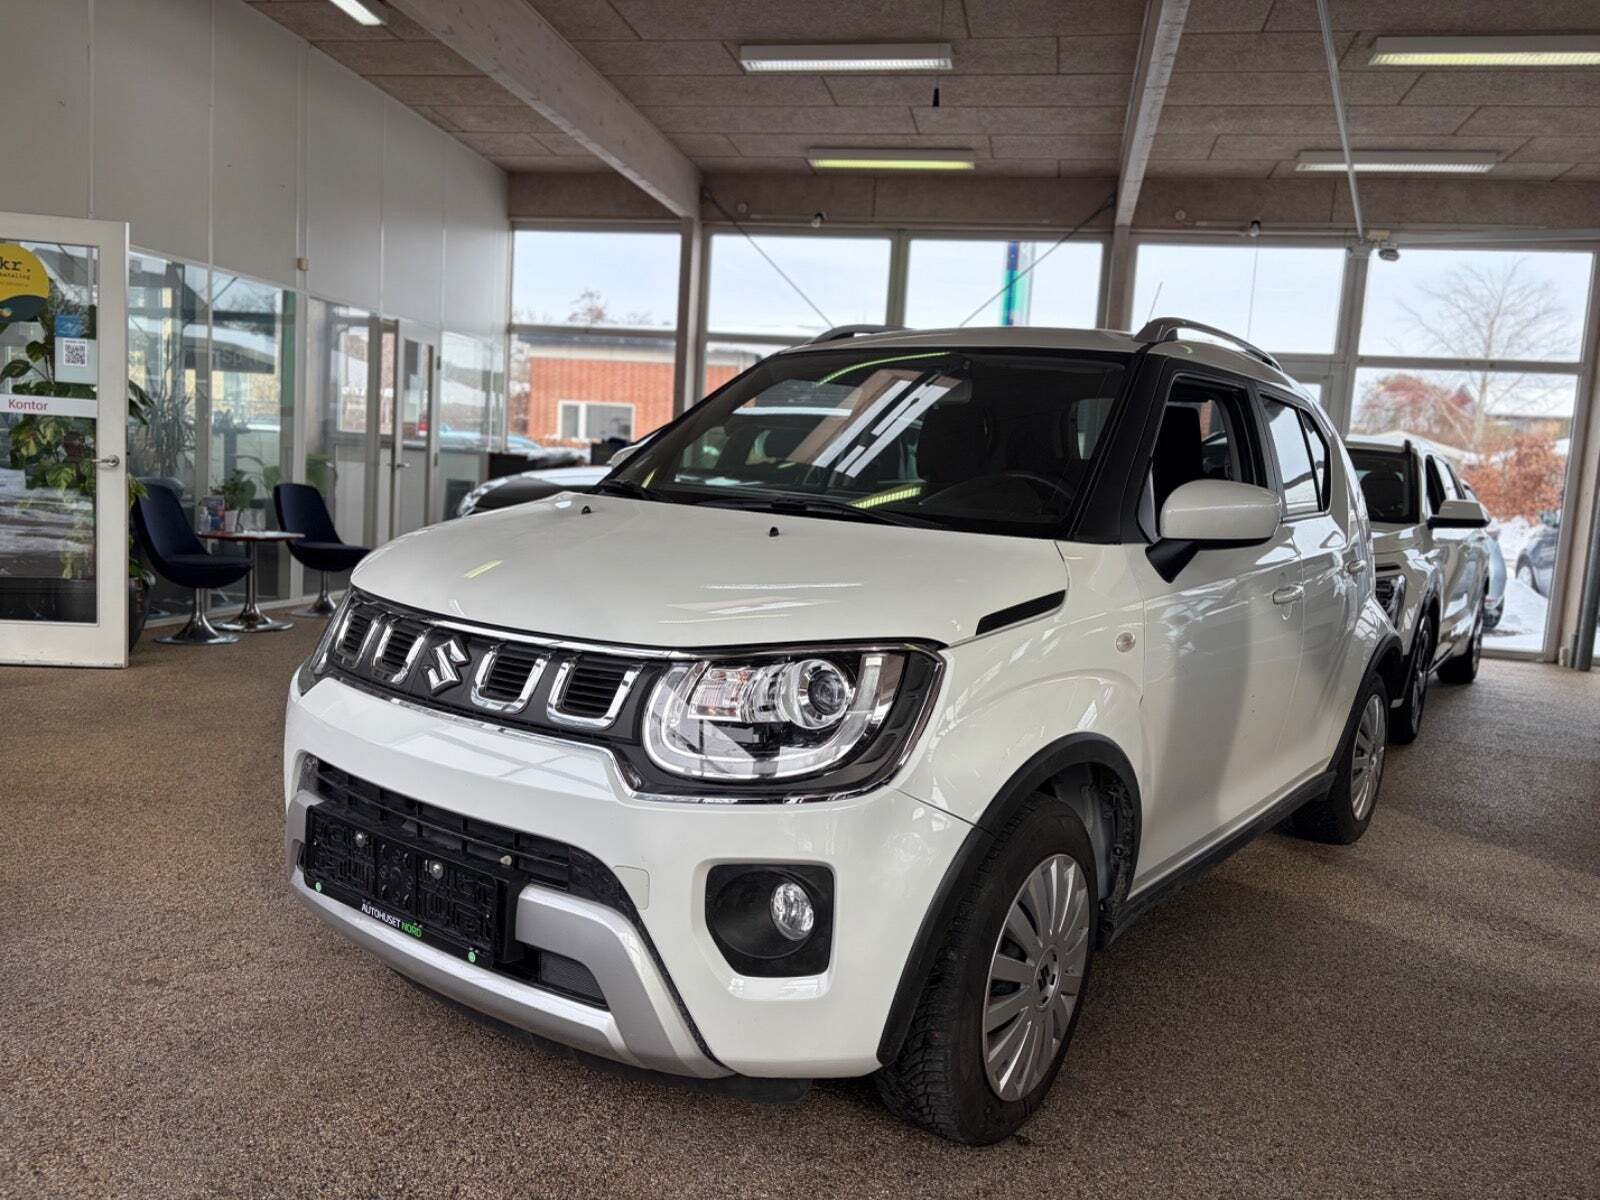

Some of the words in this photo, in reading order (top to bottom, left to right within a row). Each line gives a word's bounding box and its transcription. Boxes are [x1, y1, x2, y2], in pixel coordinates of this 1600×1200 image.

[8, 399, 48, 410] Kontor
[361, 903, 401, 928] AUTOHUSET
[401, 920, 422, 938] NORD
